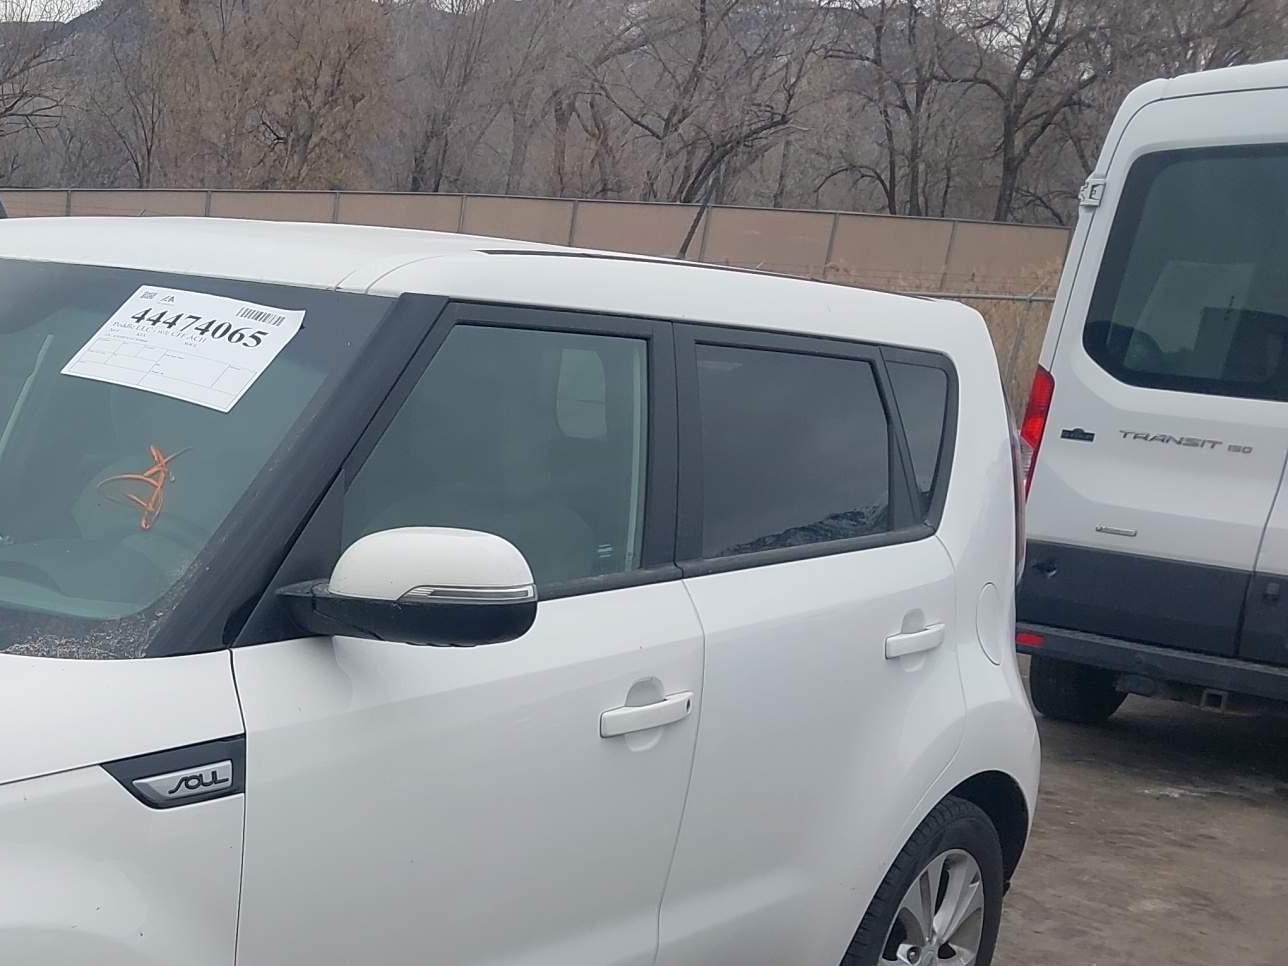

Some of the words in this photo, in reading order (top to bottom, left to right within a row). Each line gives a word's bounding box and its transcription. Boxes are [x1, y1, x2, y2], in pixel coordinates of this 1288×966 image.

[130, 307, 270, 348] 44474065
[1119, 430, 1223, 450] TRANSIT
[168, 769, 229, 795] SOUL
